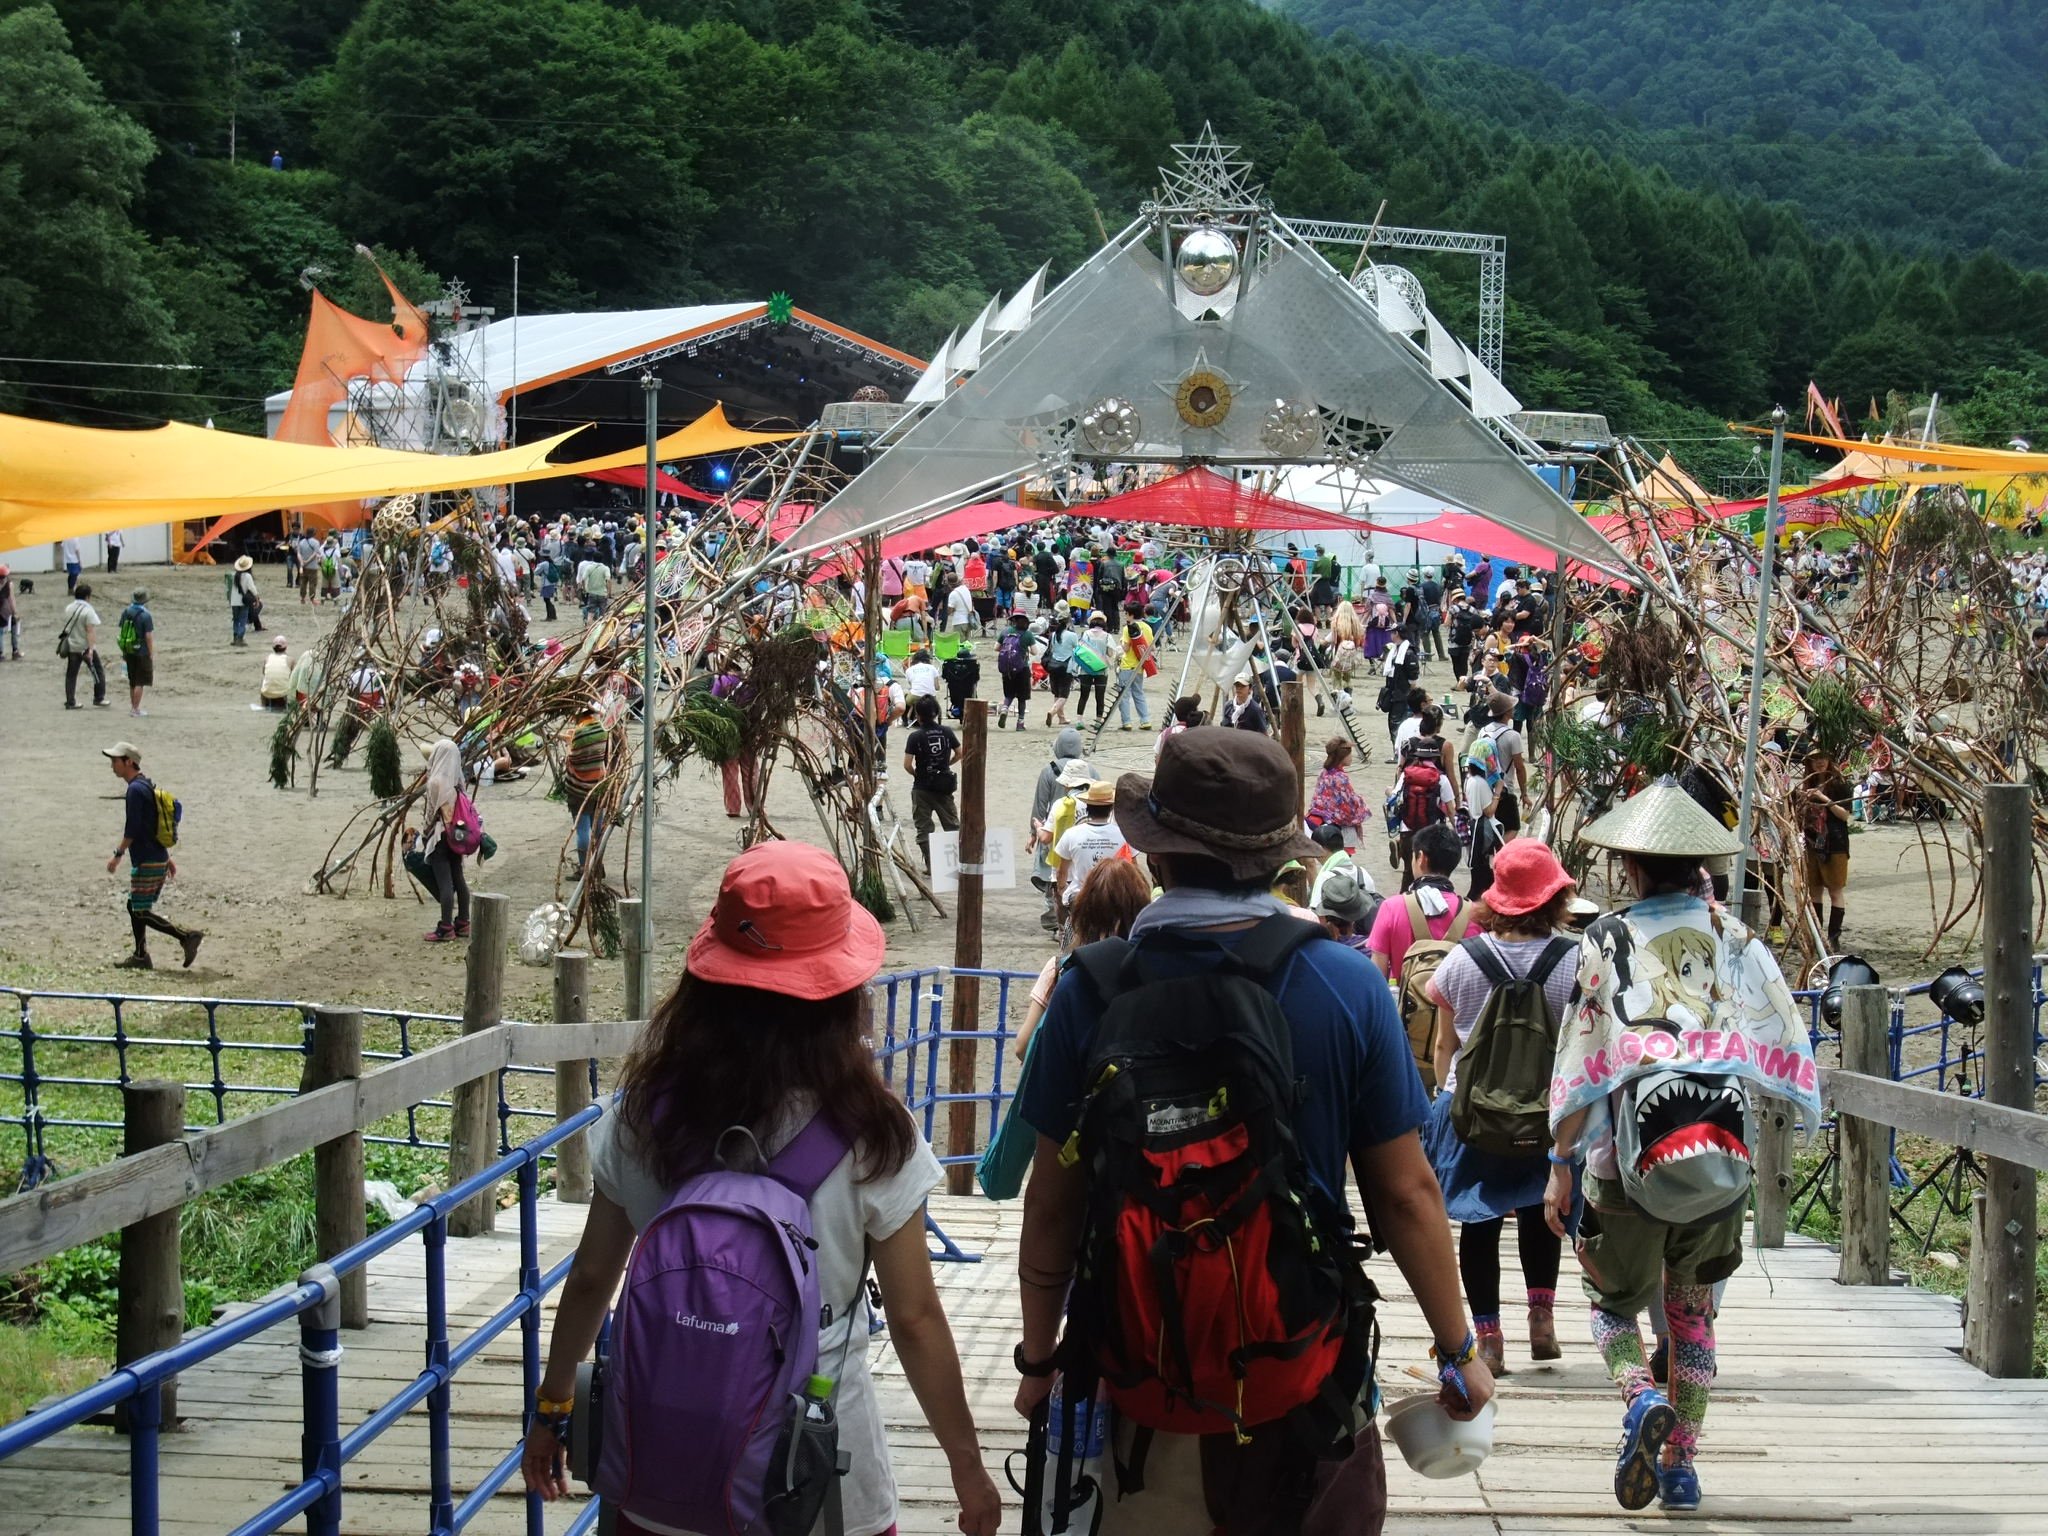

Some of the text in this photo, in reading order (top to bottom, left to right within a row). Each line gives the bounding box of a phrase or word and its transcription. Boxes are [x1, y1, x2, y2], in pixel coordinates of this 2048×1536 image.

[1681, 1031, 1748, 1062] TEA
[1749, 1037, 1816, 1092] TIME
[675, 1311, 725, 1334] Lafuma
